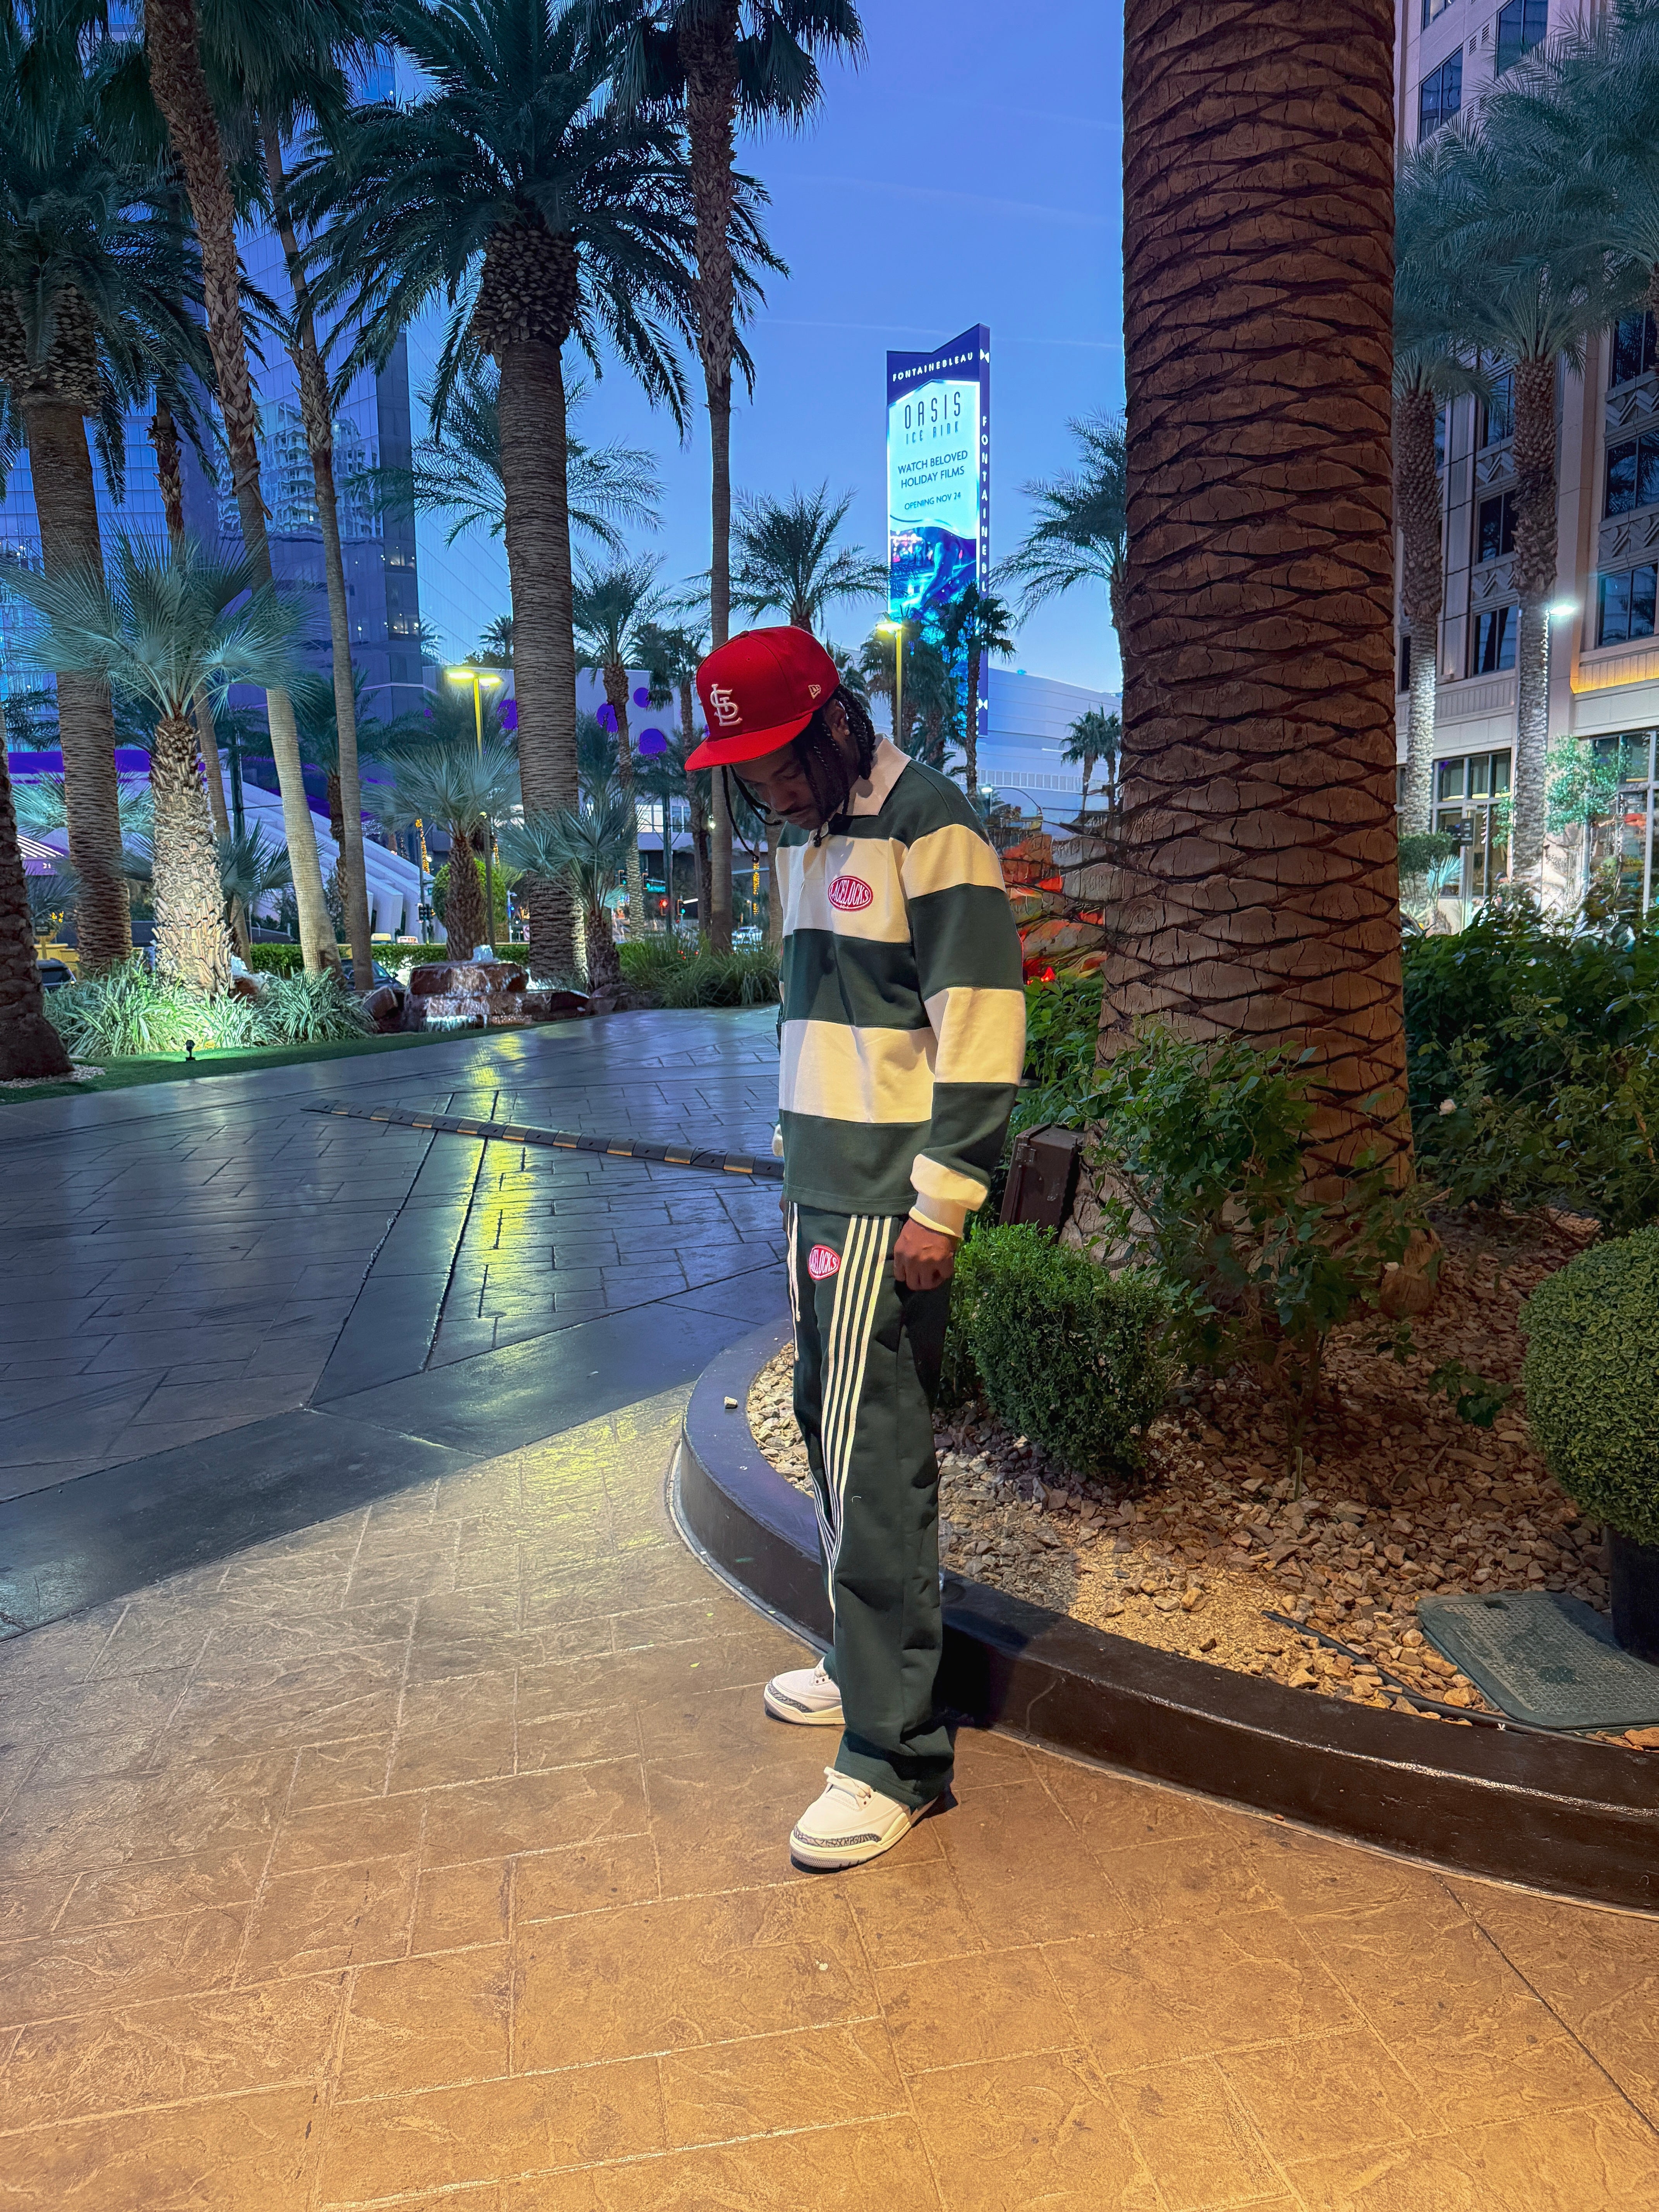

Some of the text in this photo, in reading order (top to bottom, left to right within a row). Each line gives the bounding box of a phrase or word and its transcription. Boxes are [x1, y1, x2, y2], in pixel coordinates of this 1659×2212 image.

[892, 352, 973, 382] FONTAINEBLEAU
[905, 392, 961, 429] OASIS
[906, 421, 958, 445] ICE RINK
[898, 450, 968, 474] WATCH BELOVED
[901, 466, 965, 489] HOLIDAY FILMS
[904, 491, 961, 510] OPENING NOV 24
[981, 416, 989, 645] FONTAINEBL
[830, 879, 869, 906] LACELOCKS
